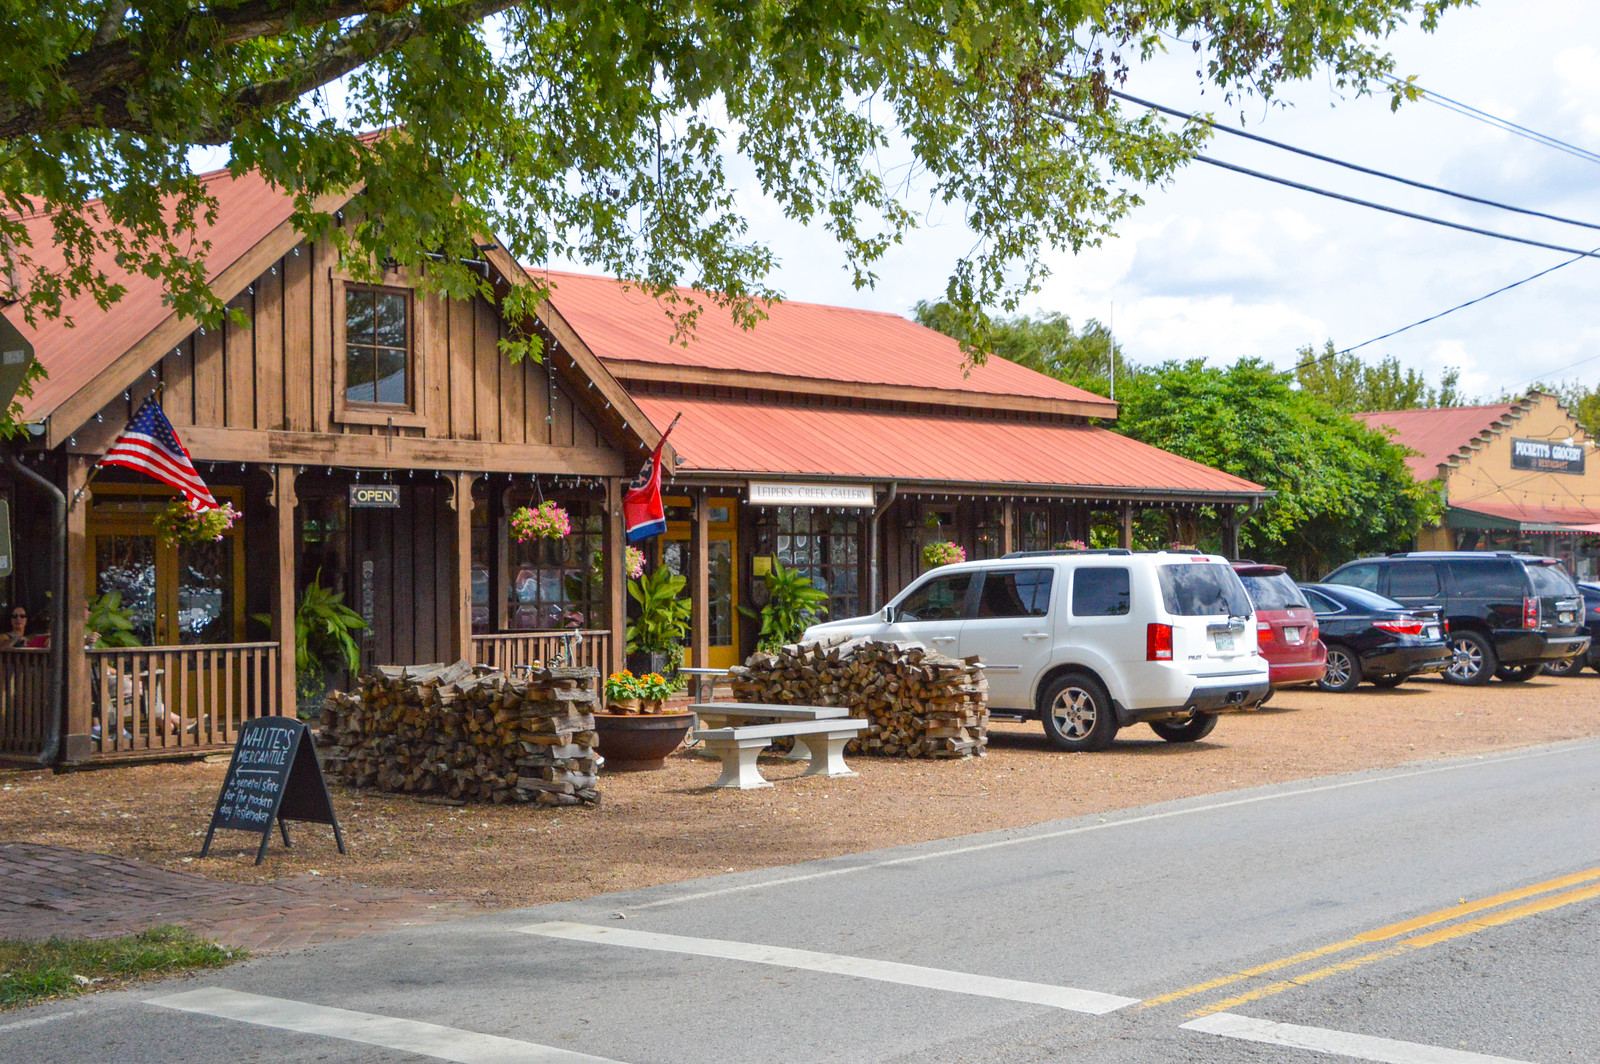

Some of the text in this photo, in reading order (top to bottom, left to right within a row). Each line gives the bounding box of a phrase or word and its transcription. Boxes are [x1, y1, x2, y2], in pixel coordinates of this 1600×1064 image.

[357, 490, 393, 502] OPEN
[757, 485, 866, 499] LEIPER'S CREEK GALLERY
[242, 727, 295, 750] WHITE'S
[237, 749, 288, 765] MERCANTILE
[234, 777, 262, 791] general
[262, 777, 279, 792] store
[224, 788, 273, 808] for the modern
